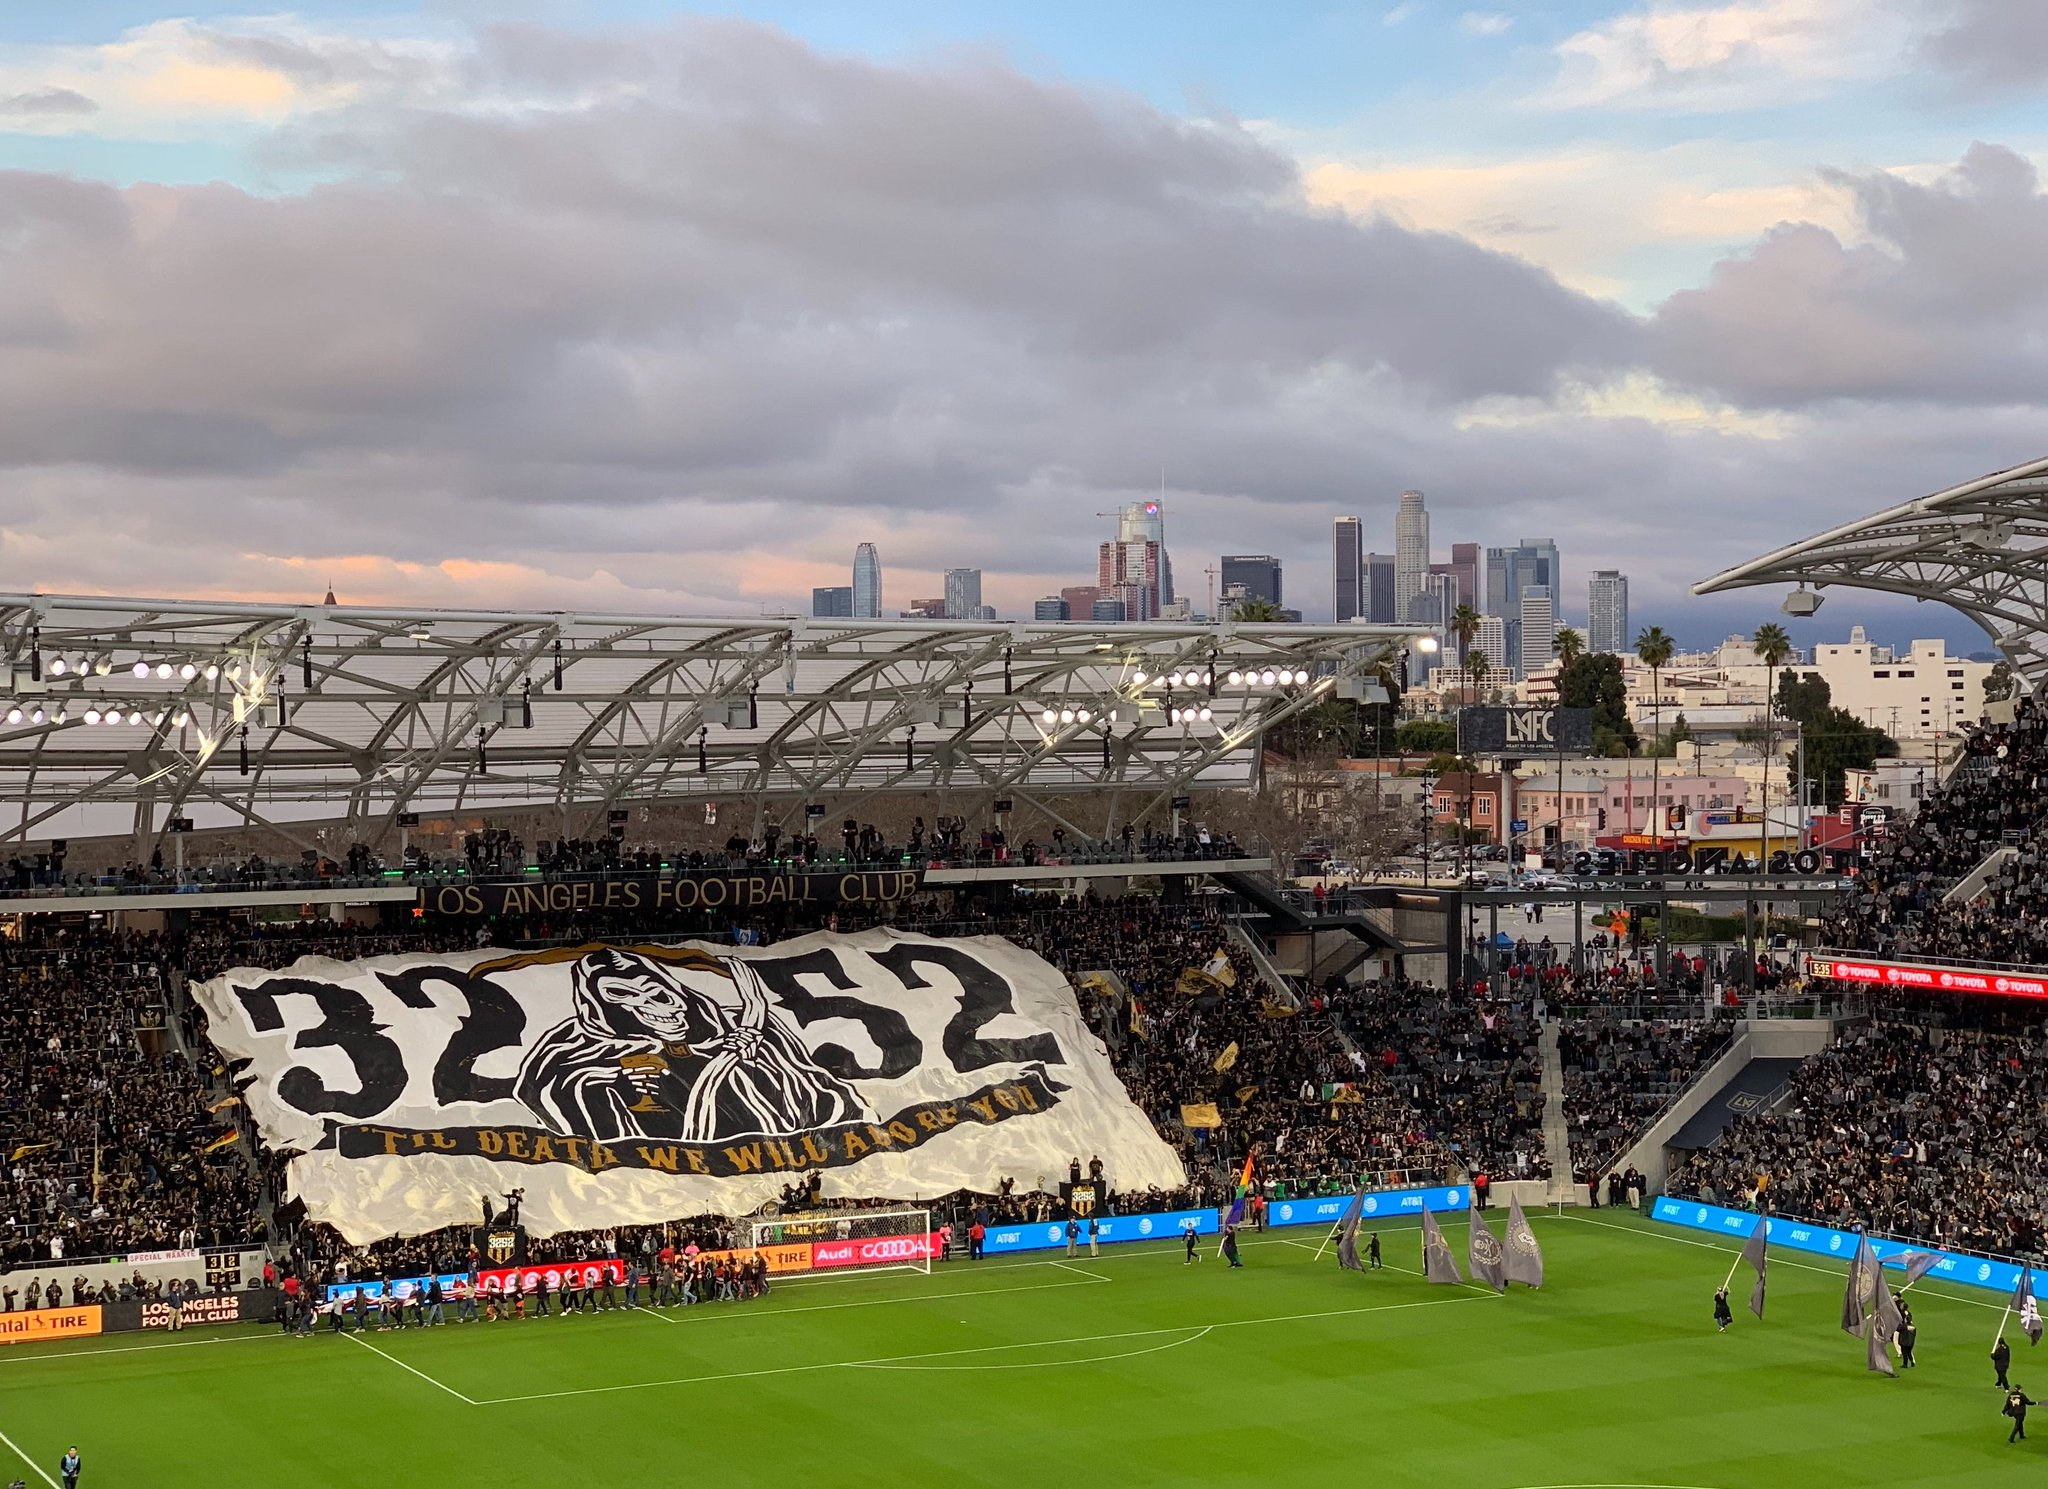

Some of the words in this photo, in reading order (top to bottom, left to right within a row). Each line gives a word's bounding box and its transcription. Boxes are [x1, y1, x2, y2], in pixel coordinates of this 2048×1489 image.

[1505, 710, 1554, 741] LAFC
[419, 885, 485, 915] LOS
[502, 881, 641, 914] ANGELES
[656, 875, 818, 908] FOOTBALL
[839, 873, 917, 901] CLUB
[1813, 963, 1830, 975] 5:35
[1850, 966, 1881, 979] TOYOTA
[1901, 970, 1933, 983] TOYOTA
[1953, 976, 1987, 989] TOYOTA
[2010, 981, 2044, 994] TOYOTA
[477, 1129, 621, 1170] DEATH
[638, 1144, 711, 1175] WE
[722, 1136, 829, 1172] WILL
[1317, 1203, 1341, 1215] AT&T
[1401, 1196, 1423, 1208] AT&T
[1662, 1204, 1681, 1217] AT&T
[1724, 1216, 1744, 1229] AT&T
[1790, 1230, 1811, 1242] AT&T
[996, 1231, 1021, 1244] AT&T
[129, 1254, 161, 1263] SPECIAL
[210, 1257, 217, 1268] 3
[228, 1255, 236, 1267] 2
[776, 1251, 807, 1264] TIRE
[817, 1247, 853, 1261] Audi
[142, 1302, 170, 1316] LOS
[179, 1296, 239, 1312] NGELES
[49, 1314, 88, 1329] TIRE
[207, 1309, 239, 1321] CLUB
